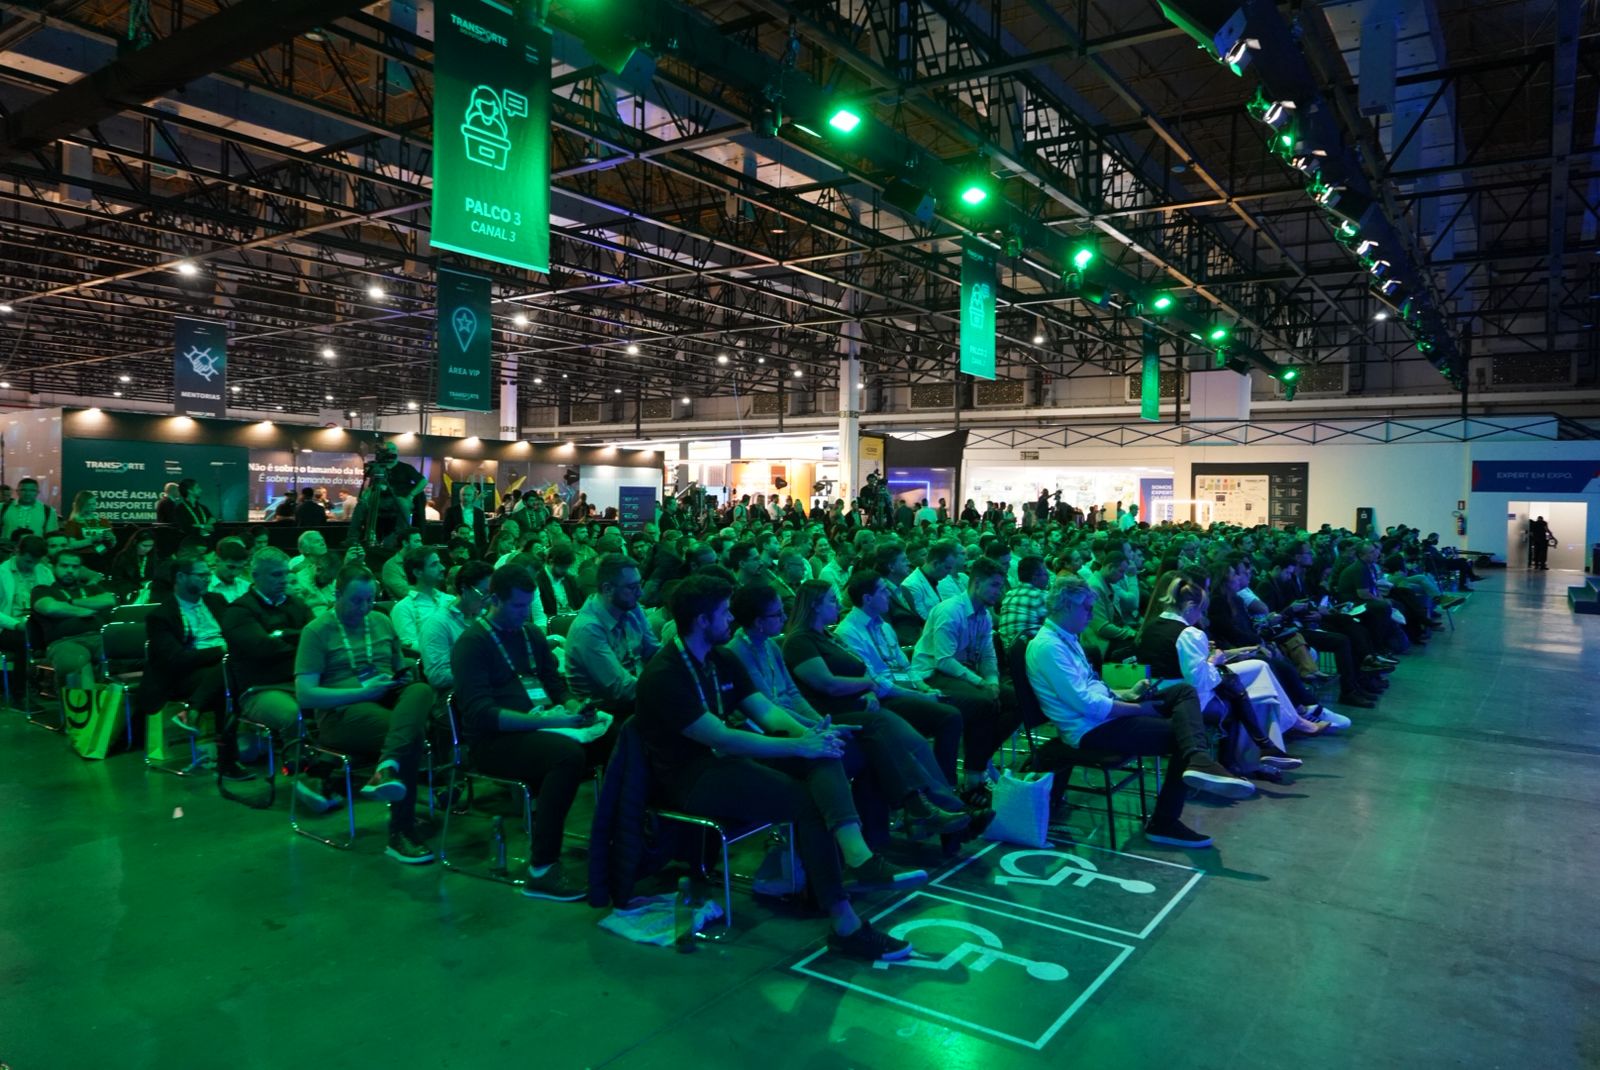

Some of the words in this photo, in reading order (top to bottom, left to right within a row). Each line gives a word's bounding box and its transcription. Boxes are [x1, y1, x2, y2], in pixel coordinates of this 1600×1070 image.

[450, 13, 508, 47] TRANSPORTE
[465, 197, 511, 223] PALCO
[513, 212, 522, 226] 3
[471, 220, 508, 240] CANAL
[509, 231, 517, 242] 3
[448, 365, 468, 376] ÁREA
[468, 368, 481, 377] VIP
[181, 391, 221, 400] MENTORIAS
[85, 460, 145, 471] TRANSPORTE
[248, 462, 266, 472] Não
[274, 464, 299, 473] sobre
[306, 466, 342, 475] tamanho
[343, 467, 354, 475] da
[258, 472, 265, 483] É
[266, 474, 289, 484] sobre
[296, 475, 332, 484] tamanho
[332, 476, 343, 485] da
[1496, 471, 1529, 479] EXPERT
[1531, 471, 1545, 479] EM
[100, 489, 129, 499] VOCÊ
[129, 491, 158, 500] ACHA
